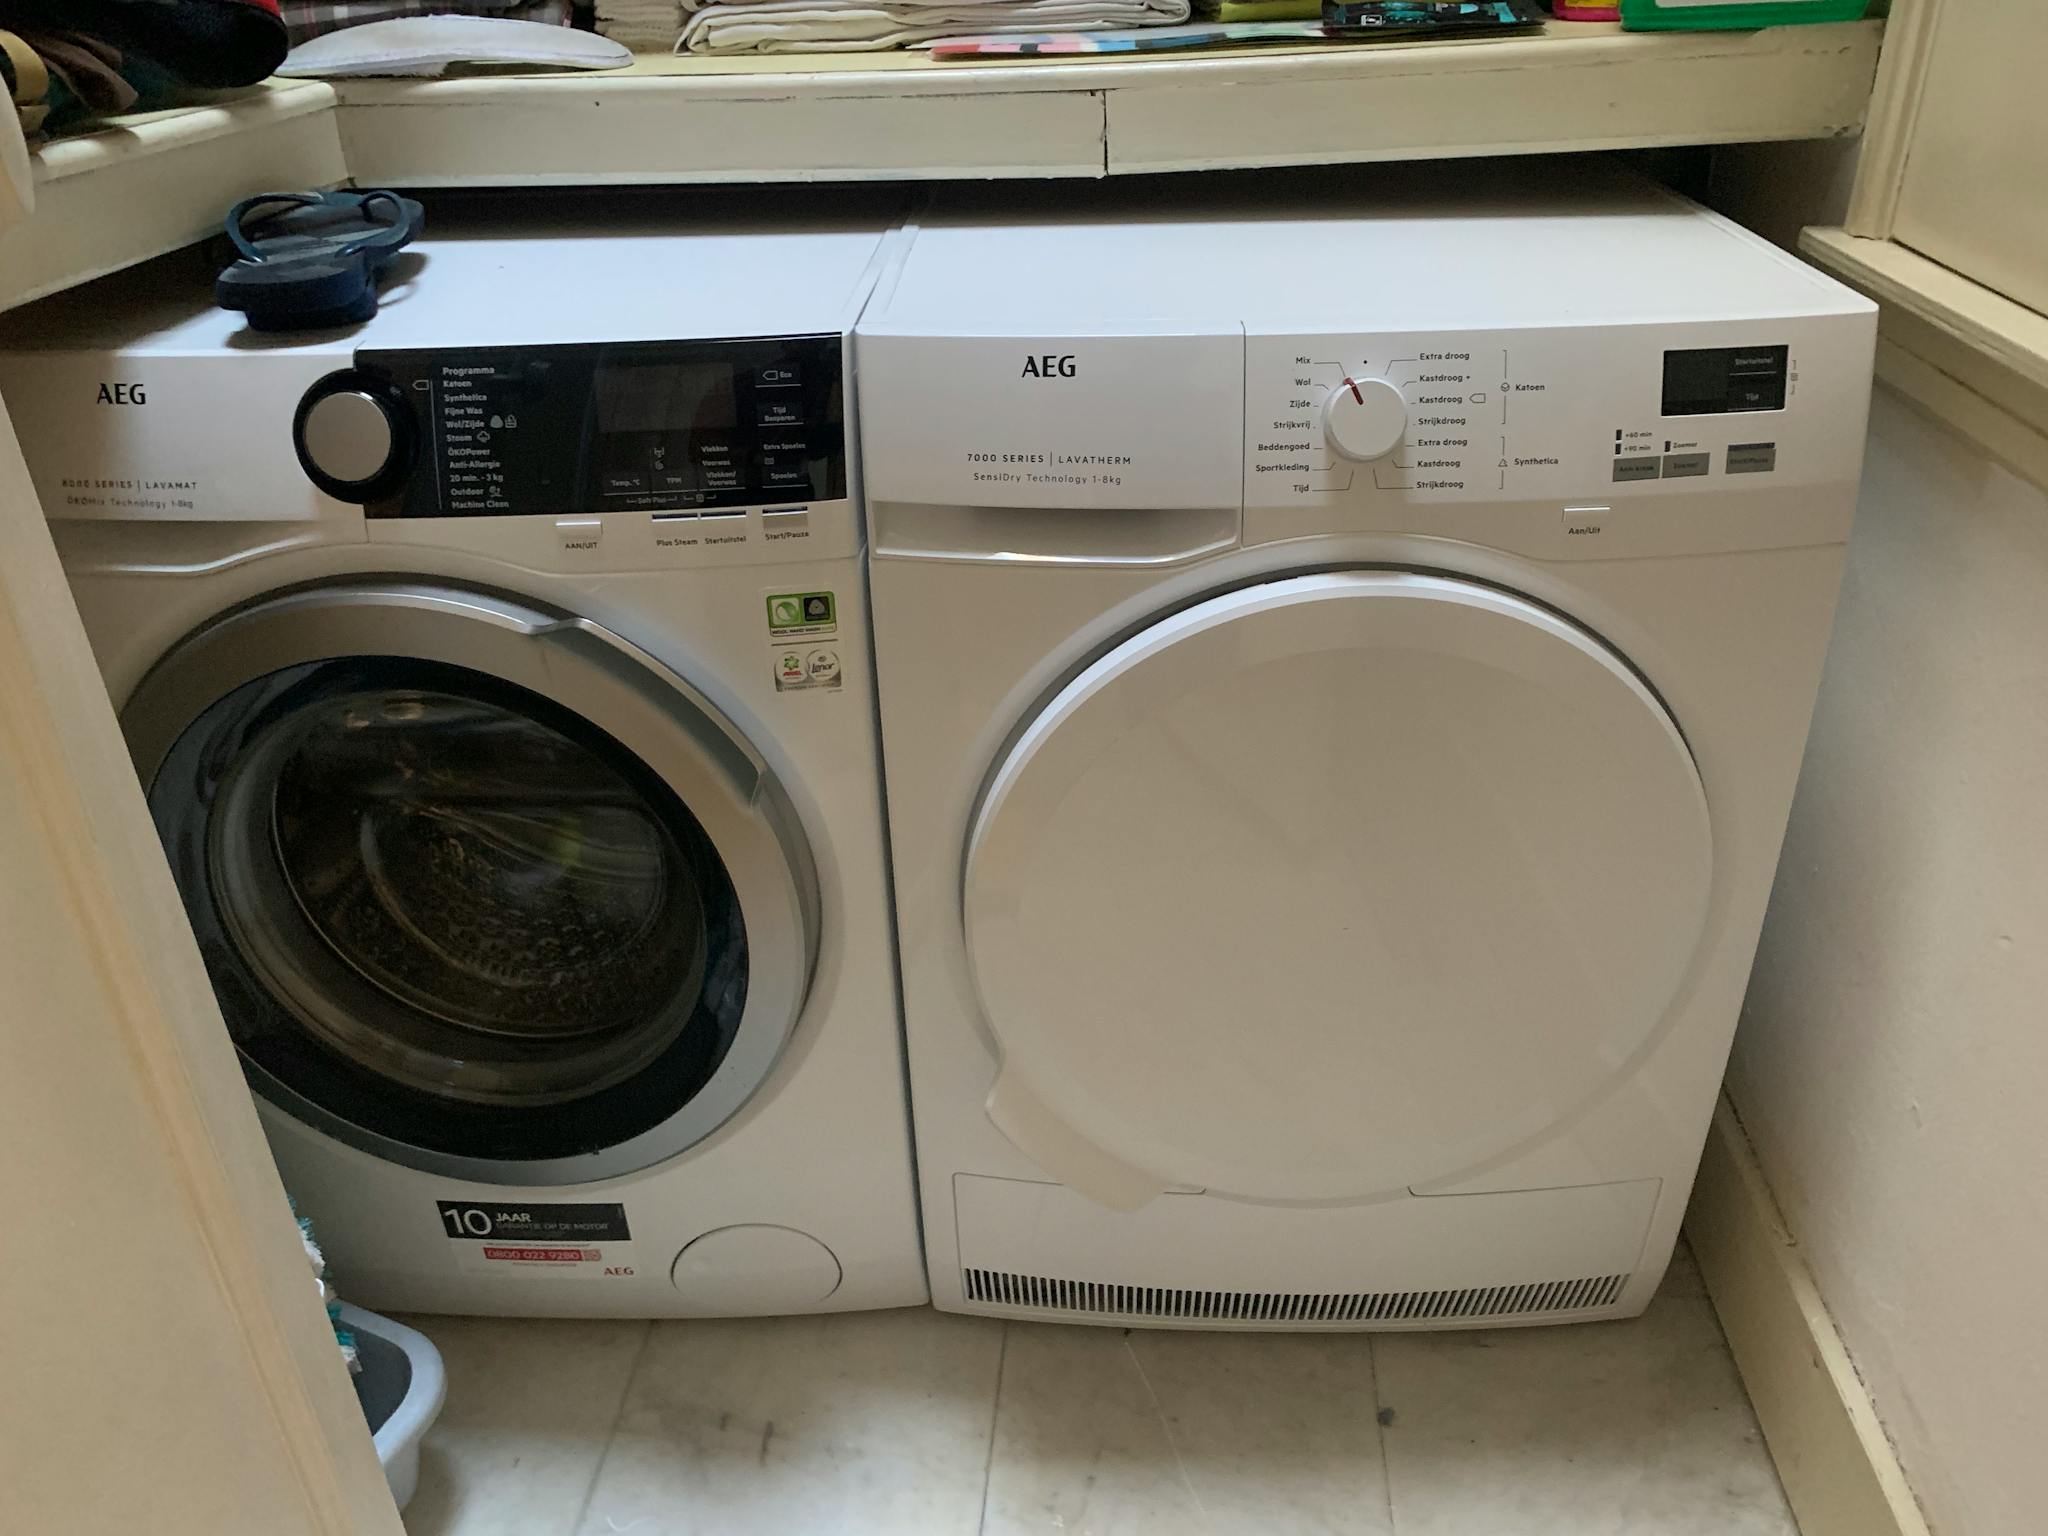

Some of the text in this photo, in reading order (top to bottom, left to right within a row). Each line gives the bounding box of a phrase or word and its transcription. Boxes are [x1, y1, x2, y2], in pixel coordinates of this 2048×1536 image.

[1295, 356, 1311, 364] Mix
[1445, 352, 1470, 360] droog
[442, 366, 495, 376] Programma
[1021, 355, 1077, 378] AEG
[1295, 378, 1311, 386] Wol
[1419, 374, 1463, 383] Kastdroog
[443, 380, 472, 388] Katoen
[1515, 383, 1545, 391] Katoen
[96, 383, 146, 405] AEG
[444, 393, 487, 402] Synthetica
[1289, 400, 1311, 408] Zijde
[1419, 396, 1462, 405] Kastdroog
[444, 407, 483, 416] Fijne Was
[446, 420, 485, 429] Wol/Zijde
[1273, 421, 1311, 430] Strijkvrij
[1418, 417, 1466, 426] Strijkdroog
[1258, 442, 1310, 451] Beddengoed
[1418, 438, 1467, 447] Extra droog
[967, 453, 1131, 465] 7000 SERIES LAVATHERM
[1417, 459, 1461, 468] Kastdroog
[1514, 457, 1559, 467] Synthetica
[449, 460, 501, 469] Anti-Allergie
[1256, 463, 1310, 472] Sportkleding
[449, 474, 461, 482] 20
[493, 473, 504, 483] kg
[973, 472, 1122, 485] SensiDry Technology 1-8kg
[95, 479, 133, 489] SERIES
[145, 480, 198, 490] LAVAMAT
[1293, 484, 1309, 493] Tijd
[1416, 480, 1464, 490] Strijkdroog
[450, 488, 484, 496] Outdoor
[111, 497, 166, 510] Technology
[451, 500, 510, 509] Machine Clean
[1568, 527, 1601, 535] Aan/Uit
[565, 541, 598, 550] AAN/UIT
[656, 537, 698, 547] Plus Steam
[495, 1212, 532, 1222] JAAR
[444, 1208, 493, 1236] 10
[574, 1222, 608, 1231] MOTOR
[487, 1249, 521, 1260] 0800
[523, 1250, 545, 1260] 022
[548, 1250, 580, 1260] 9280
[604, 1266, 634, 1276] AEG
